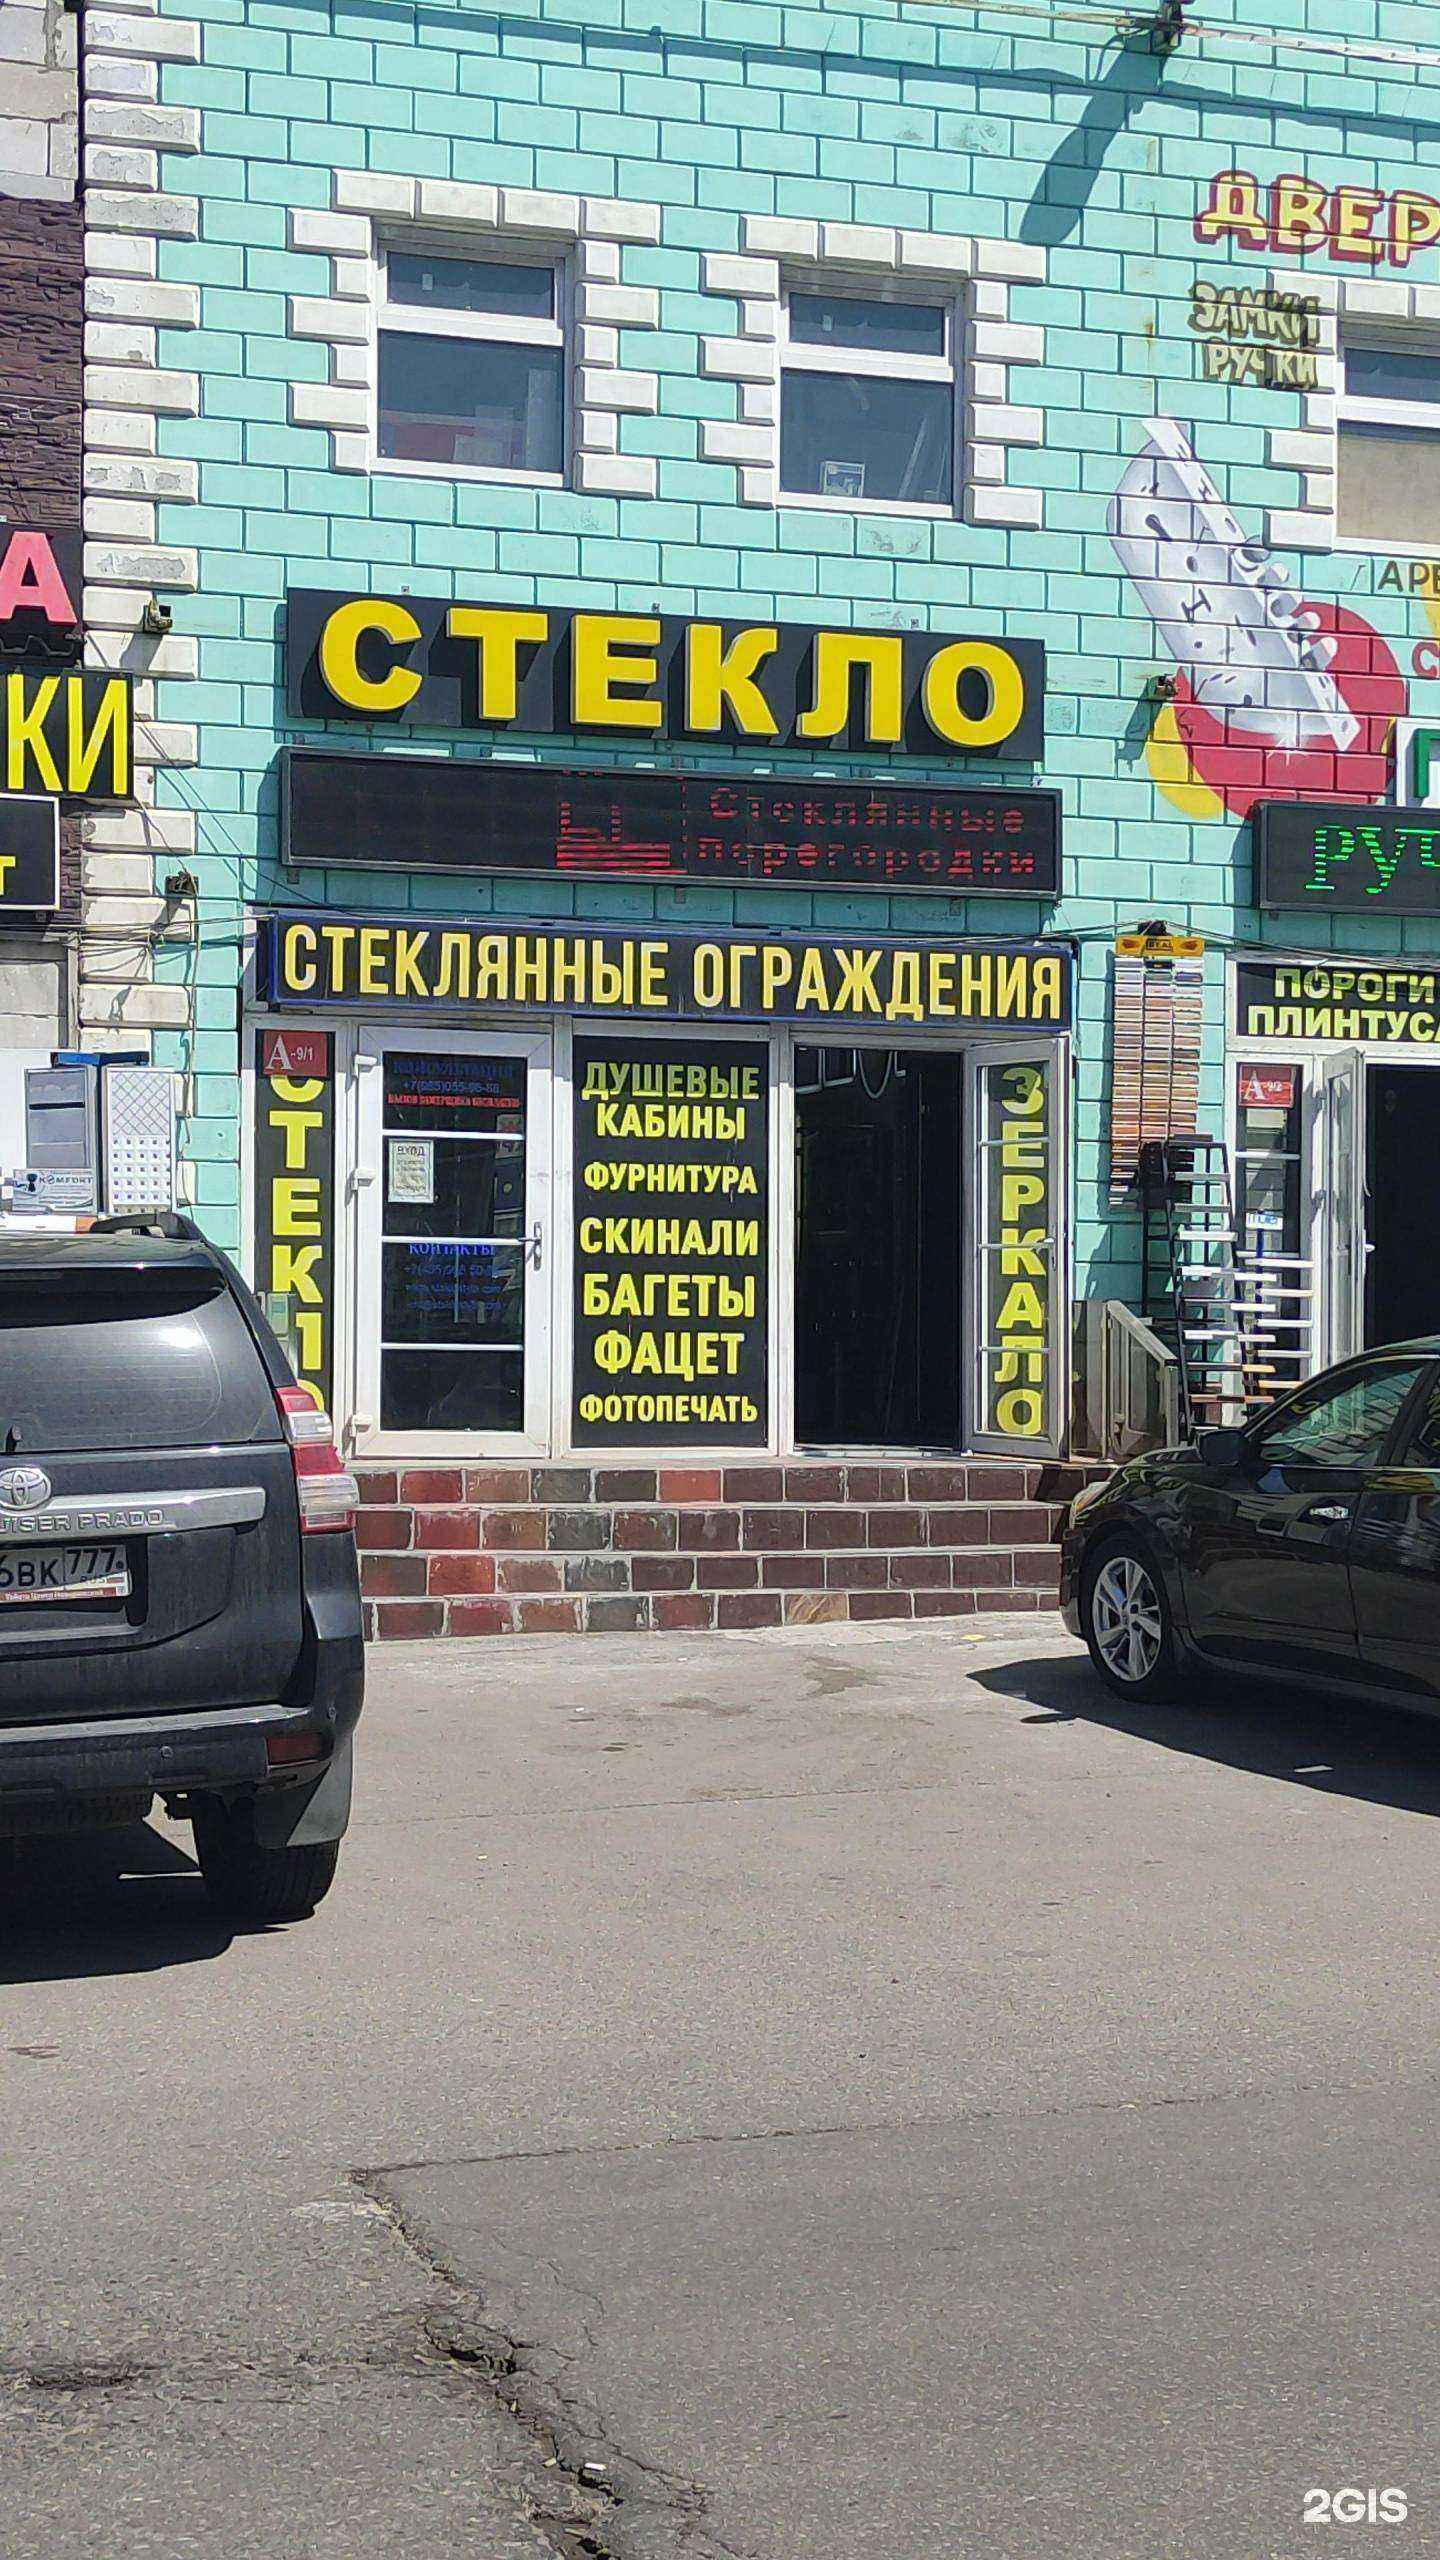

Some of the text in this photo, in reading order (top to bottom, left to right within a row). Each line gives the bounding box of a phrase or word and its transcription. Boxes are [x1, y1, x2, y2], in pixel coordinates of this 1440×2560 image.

[1194, 170, 1440, 268] ДВЕР
[1203, 337, 1318, 389] РУЧКИ
[319, 599, 1025, 748] СТЕКЛО
[7, 674, 127, 795] КИ
[283, 924, 1062, 1022] СТЕКЛЯННЫЕ ОГРАЖДЕНИЯ
[1275, 968, 1435, 1004] ПОРОГИ
[582, 1062, 760, 1100] ДУШЕВЫЕ
[597, 1103, 745, 1140] КАБИНЫ
[584, 1162, 758, 1194] ФУРНИТУРА
[580, 1217, 758, 1256] СКИНАЛИ
[994, 1067, 1046, 1435] ЗЕРКАЛО
[583, 1274, 755, 1317] БАГЕТЫ
[594, 1330, 745, 1382] ФАЦЕТ
[579, 1393, 758, 1422] ФОТОПЕЧАТЬ
[78, 1509, 164, 1529] PRADO
[66, 1548, 116, 1575] 777
